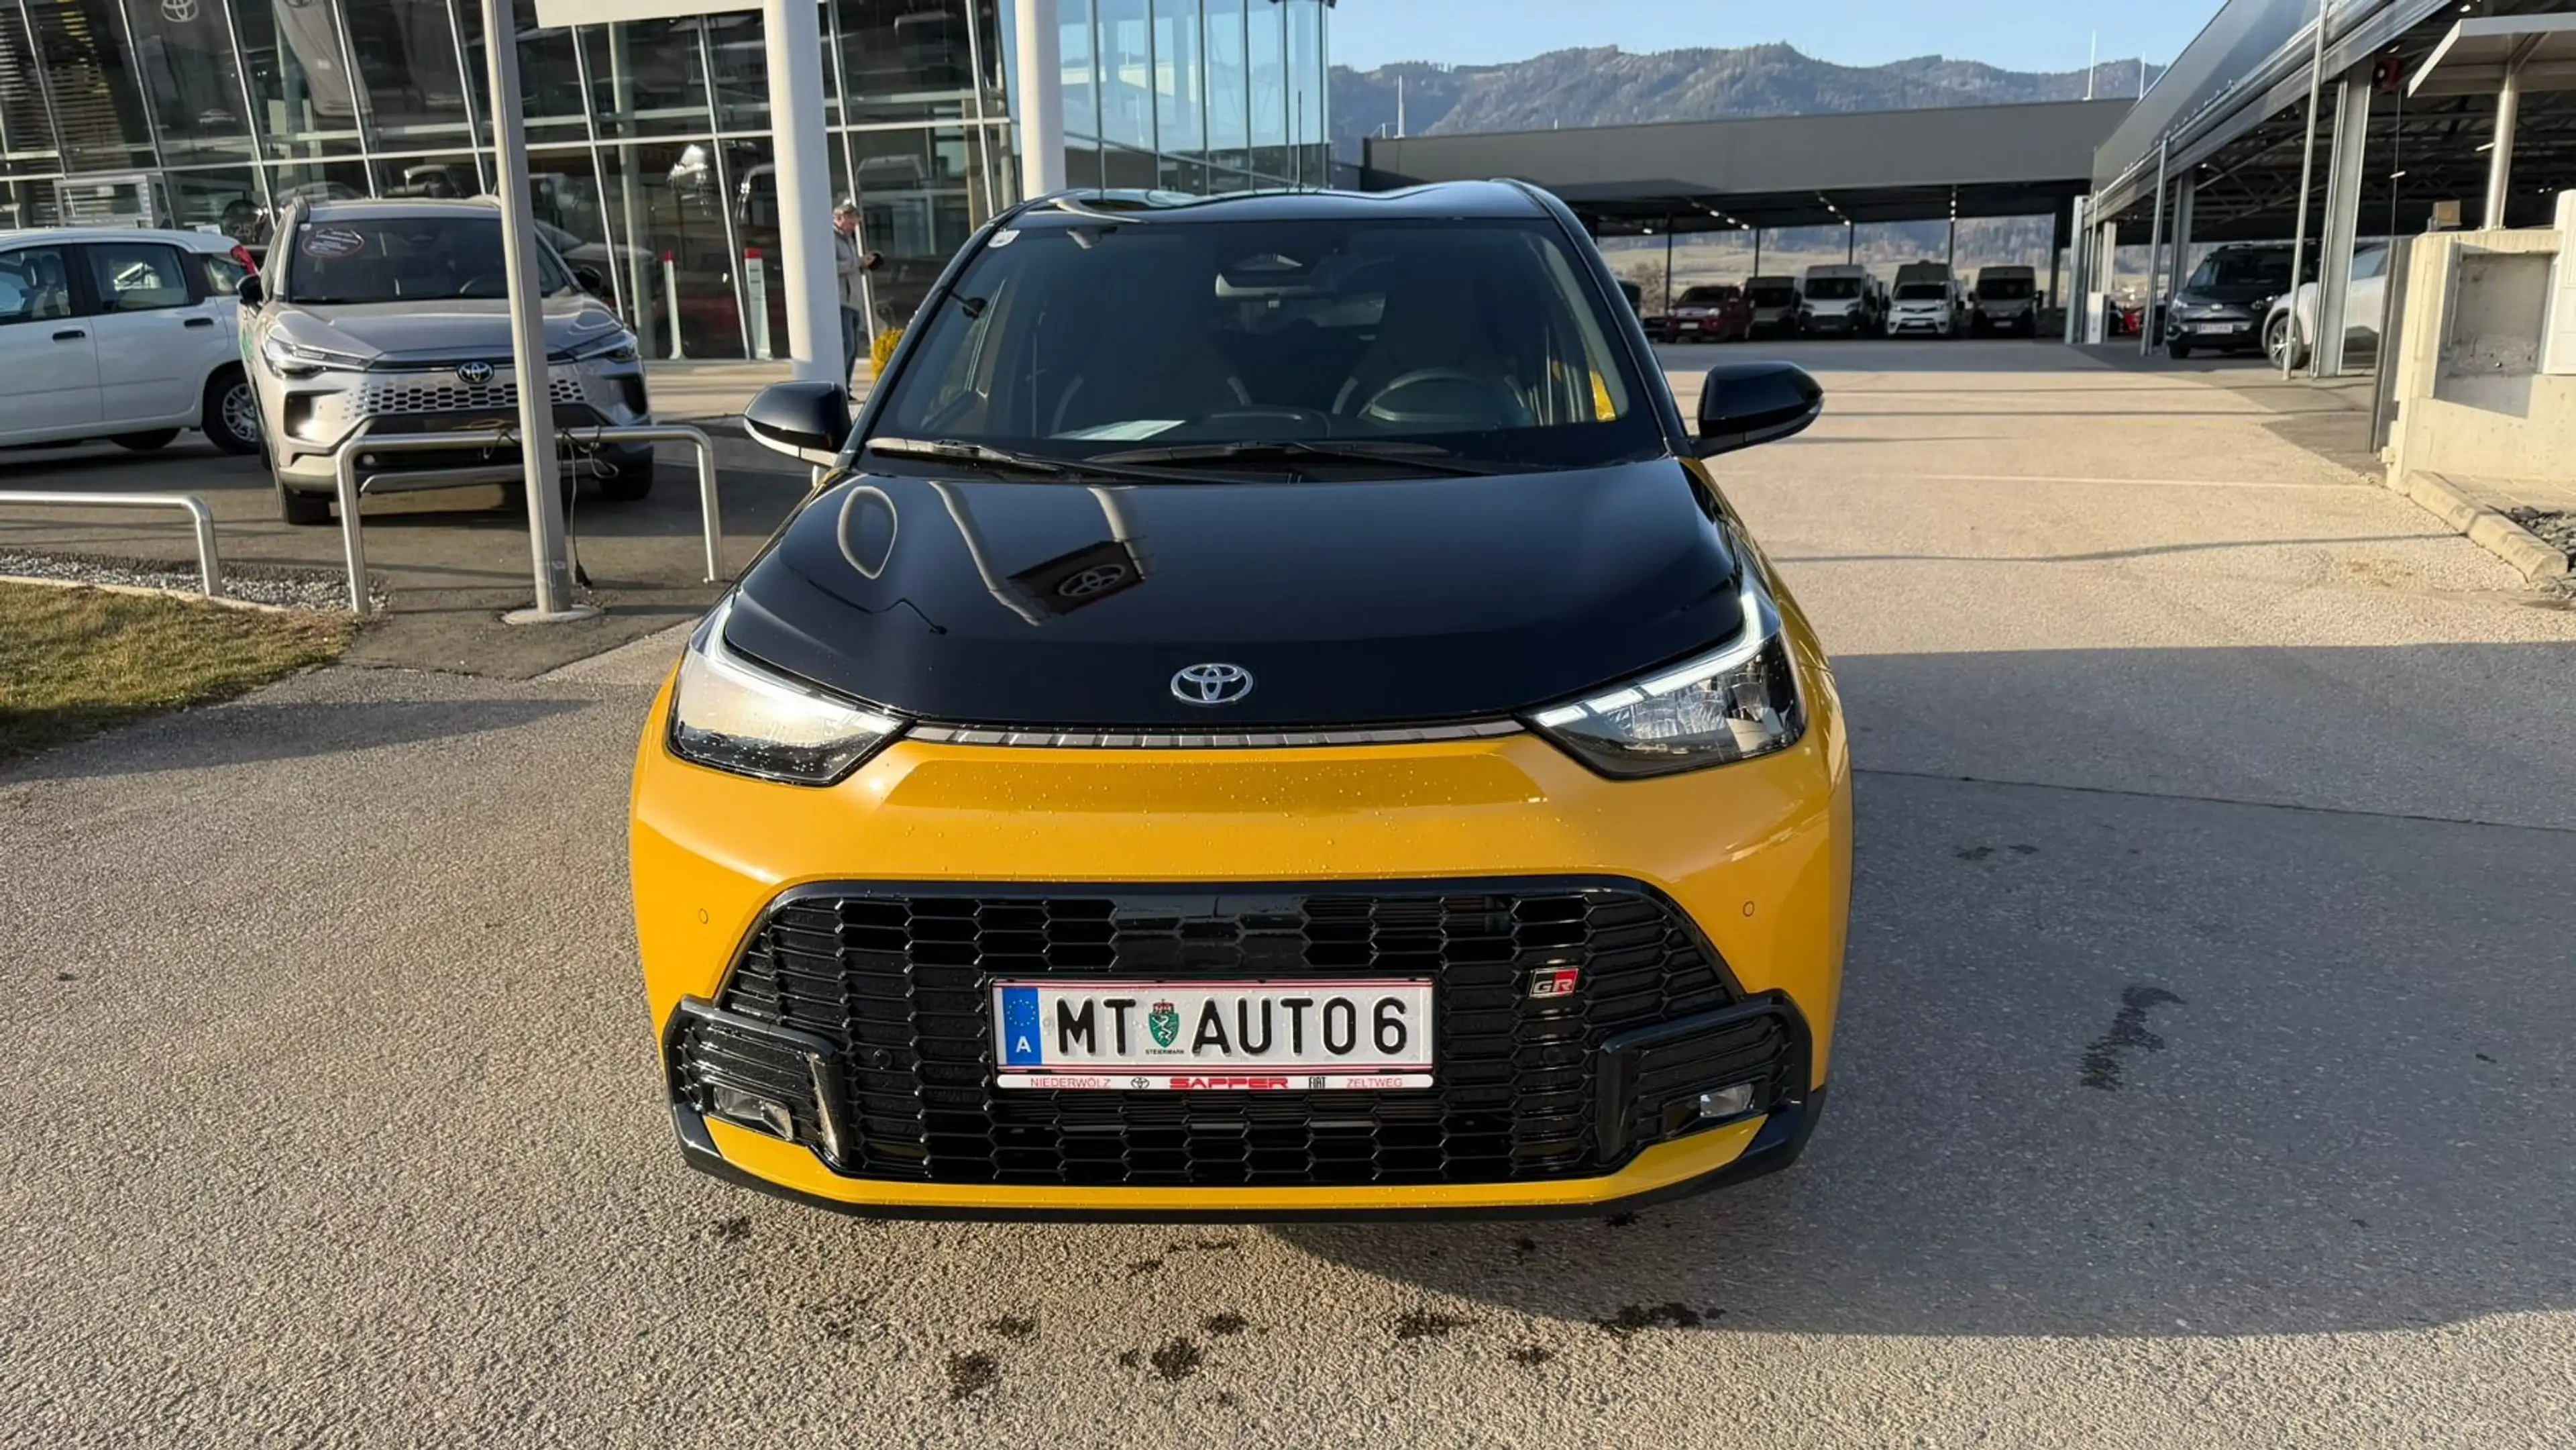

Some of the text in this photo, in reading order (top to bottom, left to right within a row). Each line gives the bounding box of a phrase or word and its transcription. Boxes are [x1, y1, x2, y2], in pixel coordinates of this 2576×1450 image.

[1532, 979, 1574, 993] GR
[1057, 997, 1136, 1056] MT
[1015, 1035, 1032, 1053] A
[1169, 1077, 1289, 1088] SAPPER
[1308, 1076, 1326, 1088] FIAT
[1346, 1078, 1403, 1088] ZELTWEG
